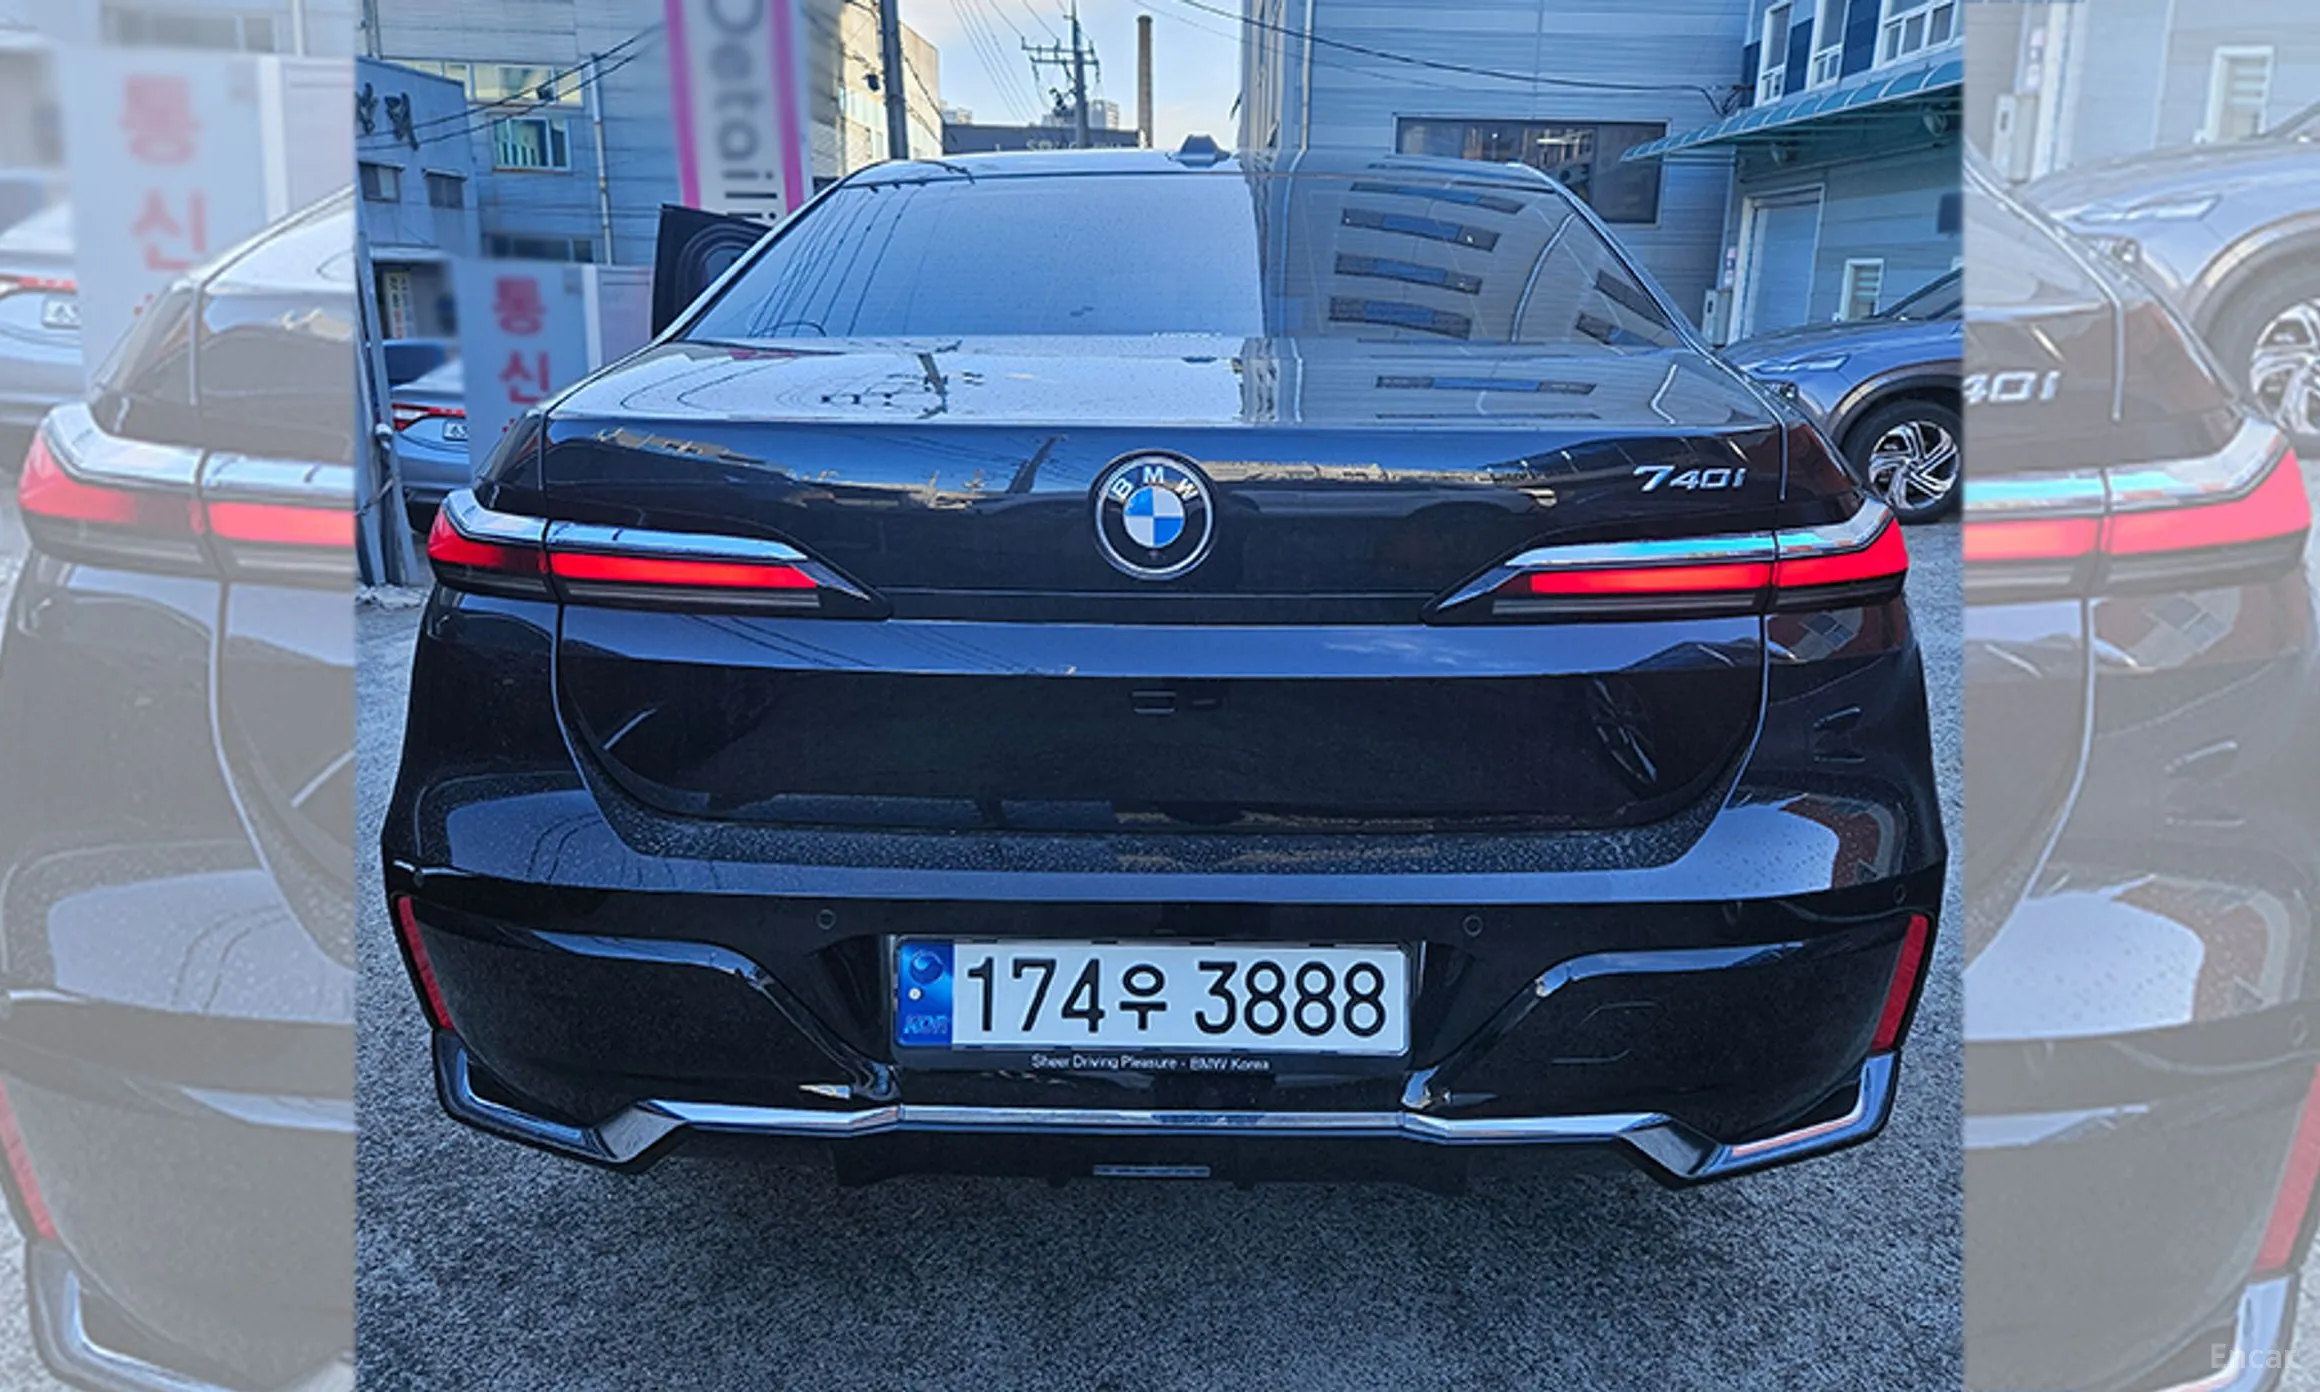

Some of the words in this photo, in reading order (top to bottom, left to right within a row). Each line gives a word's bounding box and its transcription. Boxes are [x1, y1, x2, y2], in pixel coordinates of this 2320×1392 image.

[493, 275, 549, 433] 통신
[1108, 465, 1200, 504] BMW
[1632, 465, 1747, 492] 740i
[966, 956, 1168, 1033] 174우
[1194, 960, 1388, 1038] 3888
[1031, 1053, 1070, 1070] Sheer
[1072, 1054, 1120, 1071] Driving
[1121, 1055, 1178, 1071] Pleasure
[1189, 1056, 1228, 1071] BMW
[1230, 1057, 1271, 1071] Korea
